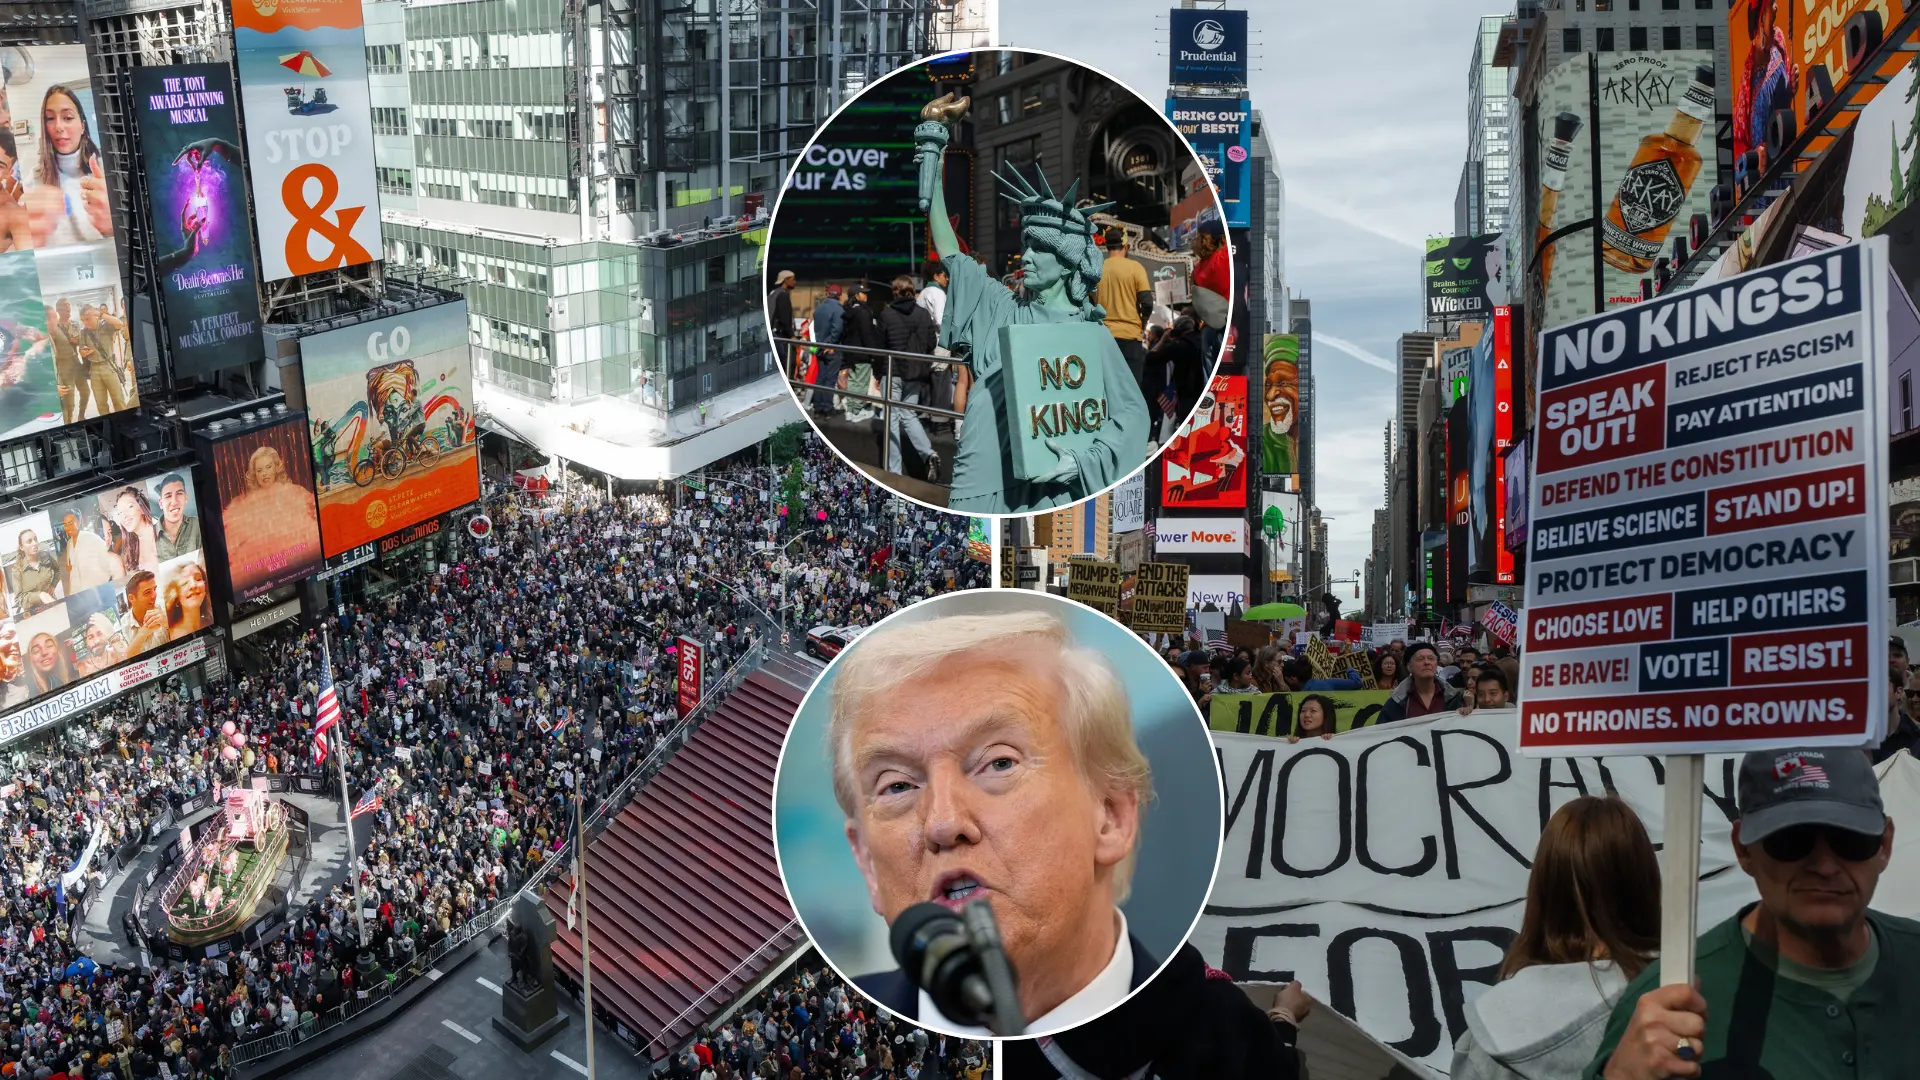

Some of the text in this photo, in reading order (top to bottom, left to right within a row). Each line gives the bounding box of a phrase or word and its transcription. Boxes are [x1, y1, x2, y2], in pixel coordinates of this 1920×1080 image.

[1180, 50, 1237, 62] Prudential
[1614, 56, 1668, 71] ZERO PROOF
[163, 76, 205, 93] THE TONY
[1602, 68, 1675, 111] ARKAY
[150, 91, 224, 110] AWARD-WINNING
[1687, 90, 1713, 104] PROOF
[170, 108, 208, 124] MUSICAL
[1173, 111, 1247, 121] BRING OUT
[1202, 124, 1239, 134] BEST!
[265, 123, 352, 164] STOP
[805, 144, 889, 169] Cover
[831, 168, 867, 191] As
[1622, 170, 1683, 214] ARKAY
[281, 163, 373, 277] &
[172, 264, 244, 290] Death Becomes Her
[1433, 278, 1480, 288] Brains. Heart.
[202, 311, 239, 330] PERFECT
[1553, 255, 1845, 378] NO KINGS!
[179, 329, 218, 349] MUSICAL
[367, 325, 410, 362] GO
[1674, 330, 1854, 389] REJECT FASCISM
[1038, 354, 1086, 391] NO
[1545, 379, 1655, 432] SPEAK
[1675, 377, 1854, 433] PAY ATTENTION!
[1560, 414, 1636, 456] OUT!
[1541, 426, 1854, 507] DEFEND THE CONSTITUTION
[1114, 499, 1143, 521] SQUARE
[1714, 478, 1855, 524] STAND UP!
[1191, 531, 1236, 543] Move.
[1536, 503, 1698, 552] BELIEVE SCIENCE
[354, 542, 374, 559] FIN
[382, 535, 399, 553] DOS
[1071, 563, 1118, 584] TRUMP &
[1138, 563, 1187, 582] END THE
[1537, 531, 1855, 596] PROTECT DEMOCRACY
[1136, 580, 1186, 598] ATTACKS
[1192, 591, 1223, 603] New
[1105, 602, 1116, 614] OF
[1135, 599, 1184, 613] ON OUR
[1692, 586, 1846, 627] HELP OTHERS
[250, 608, 285, 628] HEYTEA
[1133, 613, 1184, 625] HEALTHCARE!
[1534, 605, 1663, 642] CHOOSE LOVE
[1310, 634, 1325, 654] END
[683, 645, 697, 682] tkts
[1346, 652, 1368, 668] THE
[1644, 649, 1720, 680] VOTE!
[1744, 638, 1852, 673] RESIST!
[120, 662, 148, 676] DISCOUNT
[124, 671, 140, 681] GIFTS
[1532, 657, 1629, 687] BE BRAVE!
[120, 672, 153, 688] SOUVENIRS
[1529, 697, 1854, 734] NO THRONES. NO CROWNS.
[1793, 751, 1825, 759] CANADA
